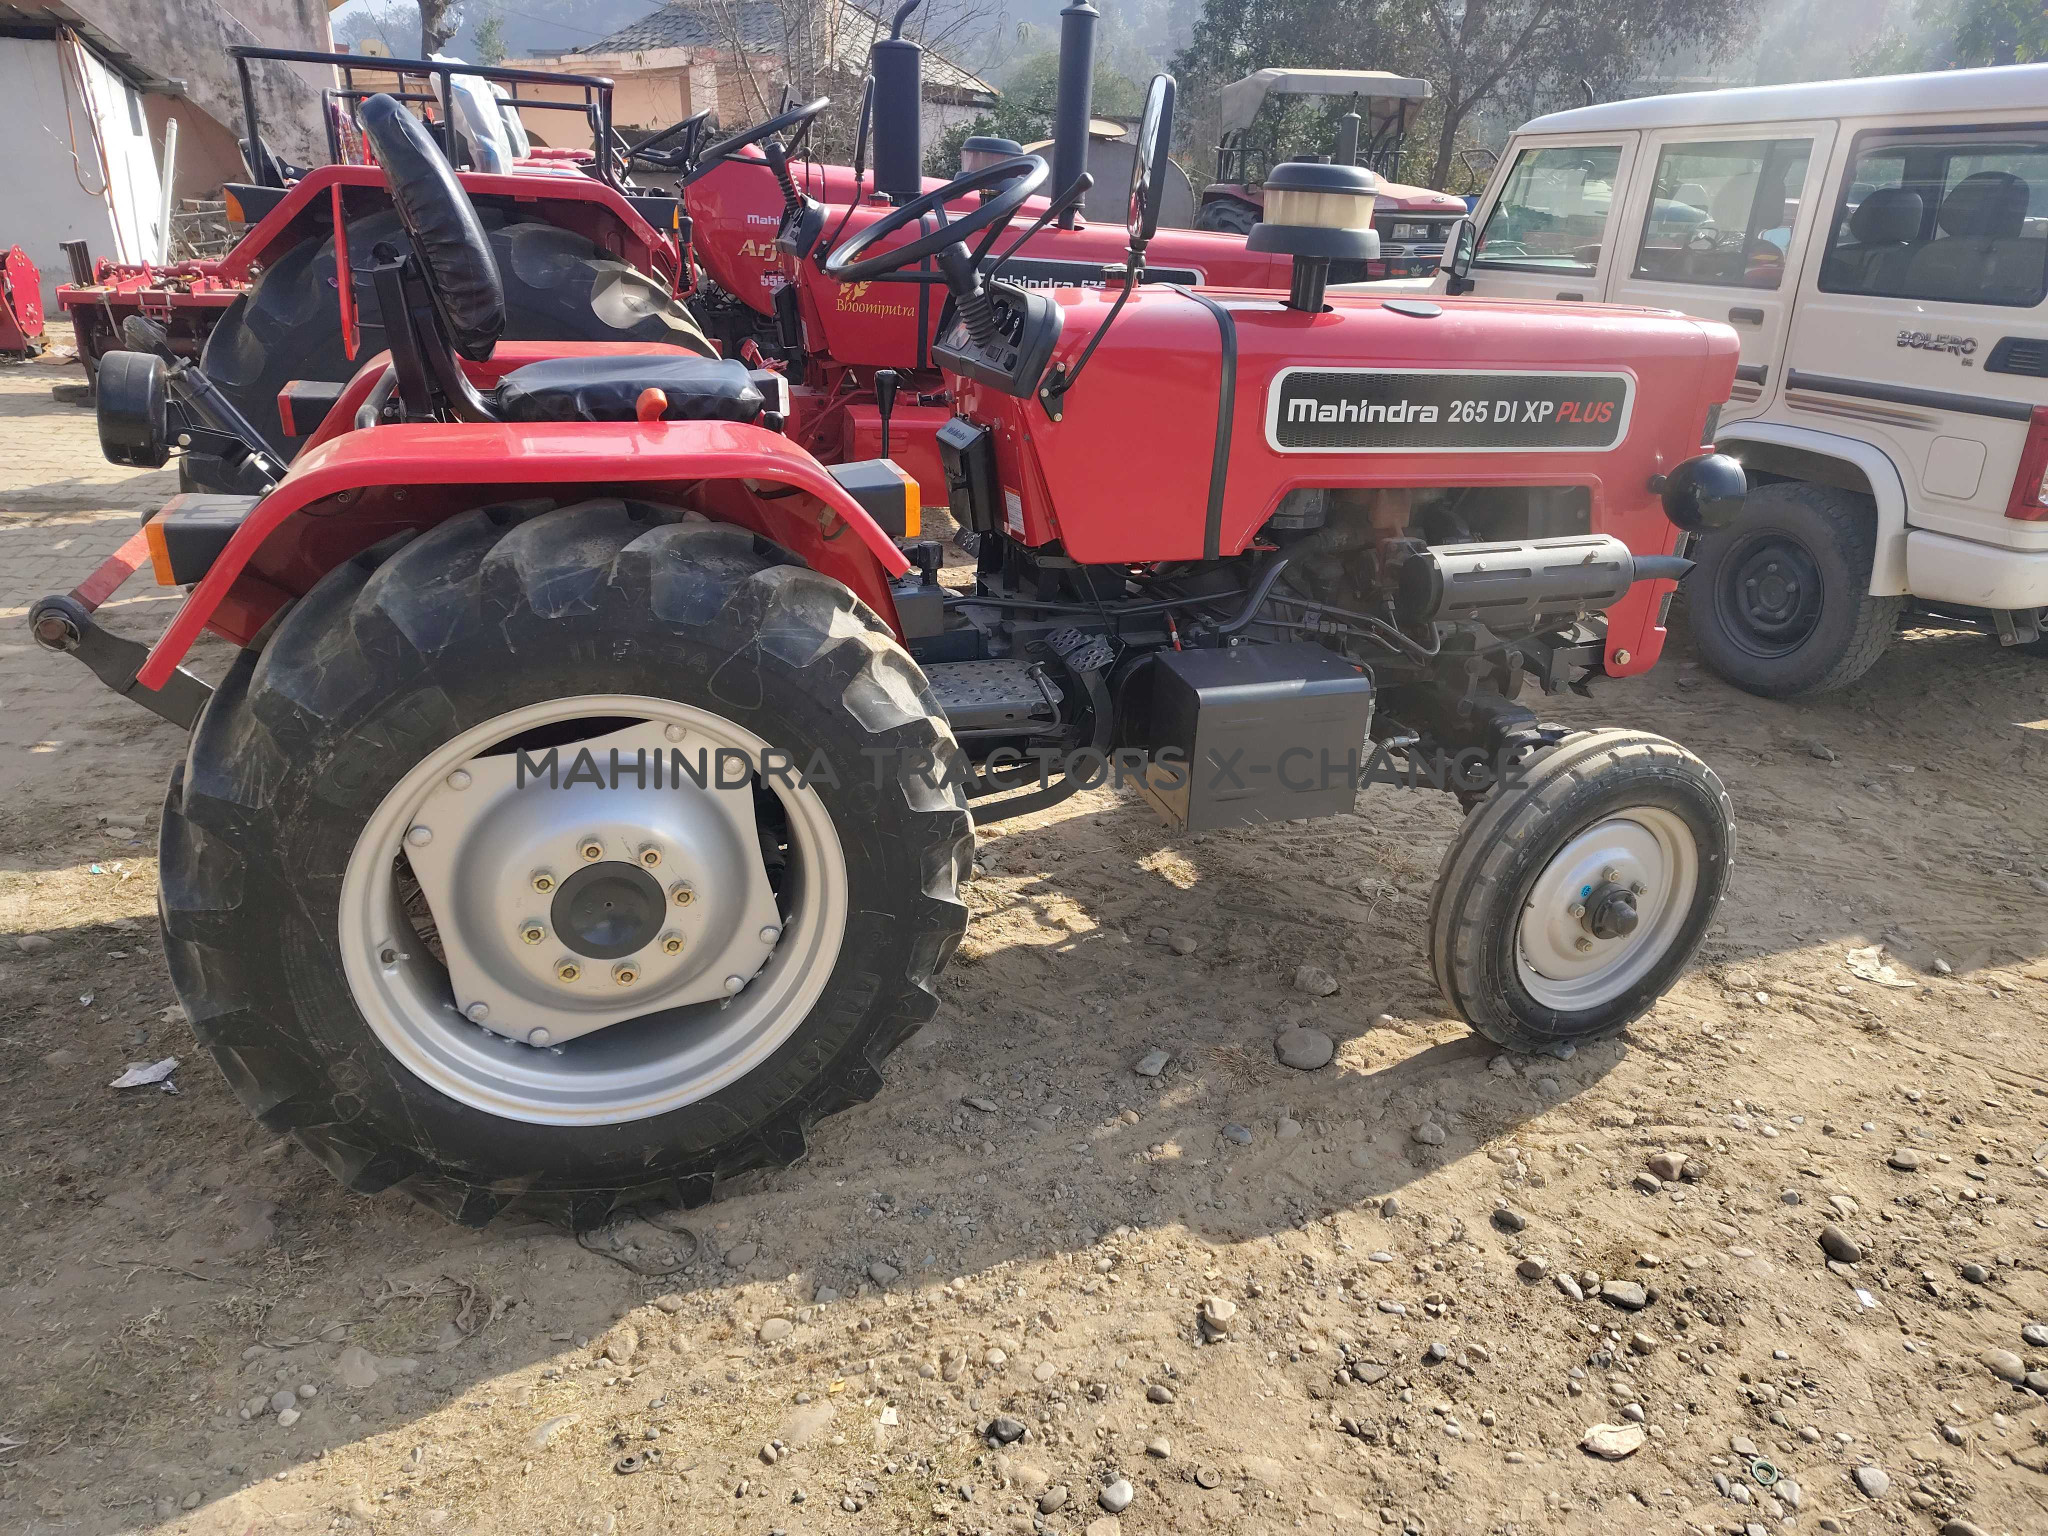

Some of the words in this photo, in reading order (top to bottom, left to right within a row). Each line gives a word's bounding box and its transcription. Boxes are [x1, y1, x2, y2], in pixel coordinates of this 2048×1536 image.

[836, 299, 916, 319] Bhoomiputra
[1897, 331, 1978, 356] BOLERO
[1287, 398, 1439, 423] Mahindra
[1448, 400, 1488, 424] 265
[1494, 401, 1517, 423] DI
[1524, 401, 1554, 424] XP
[1555, 402, 1615, 424] PLUS
